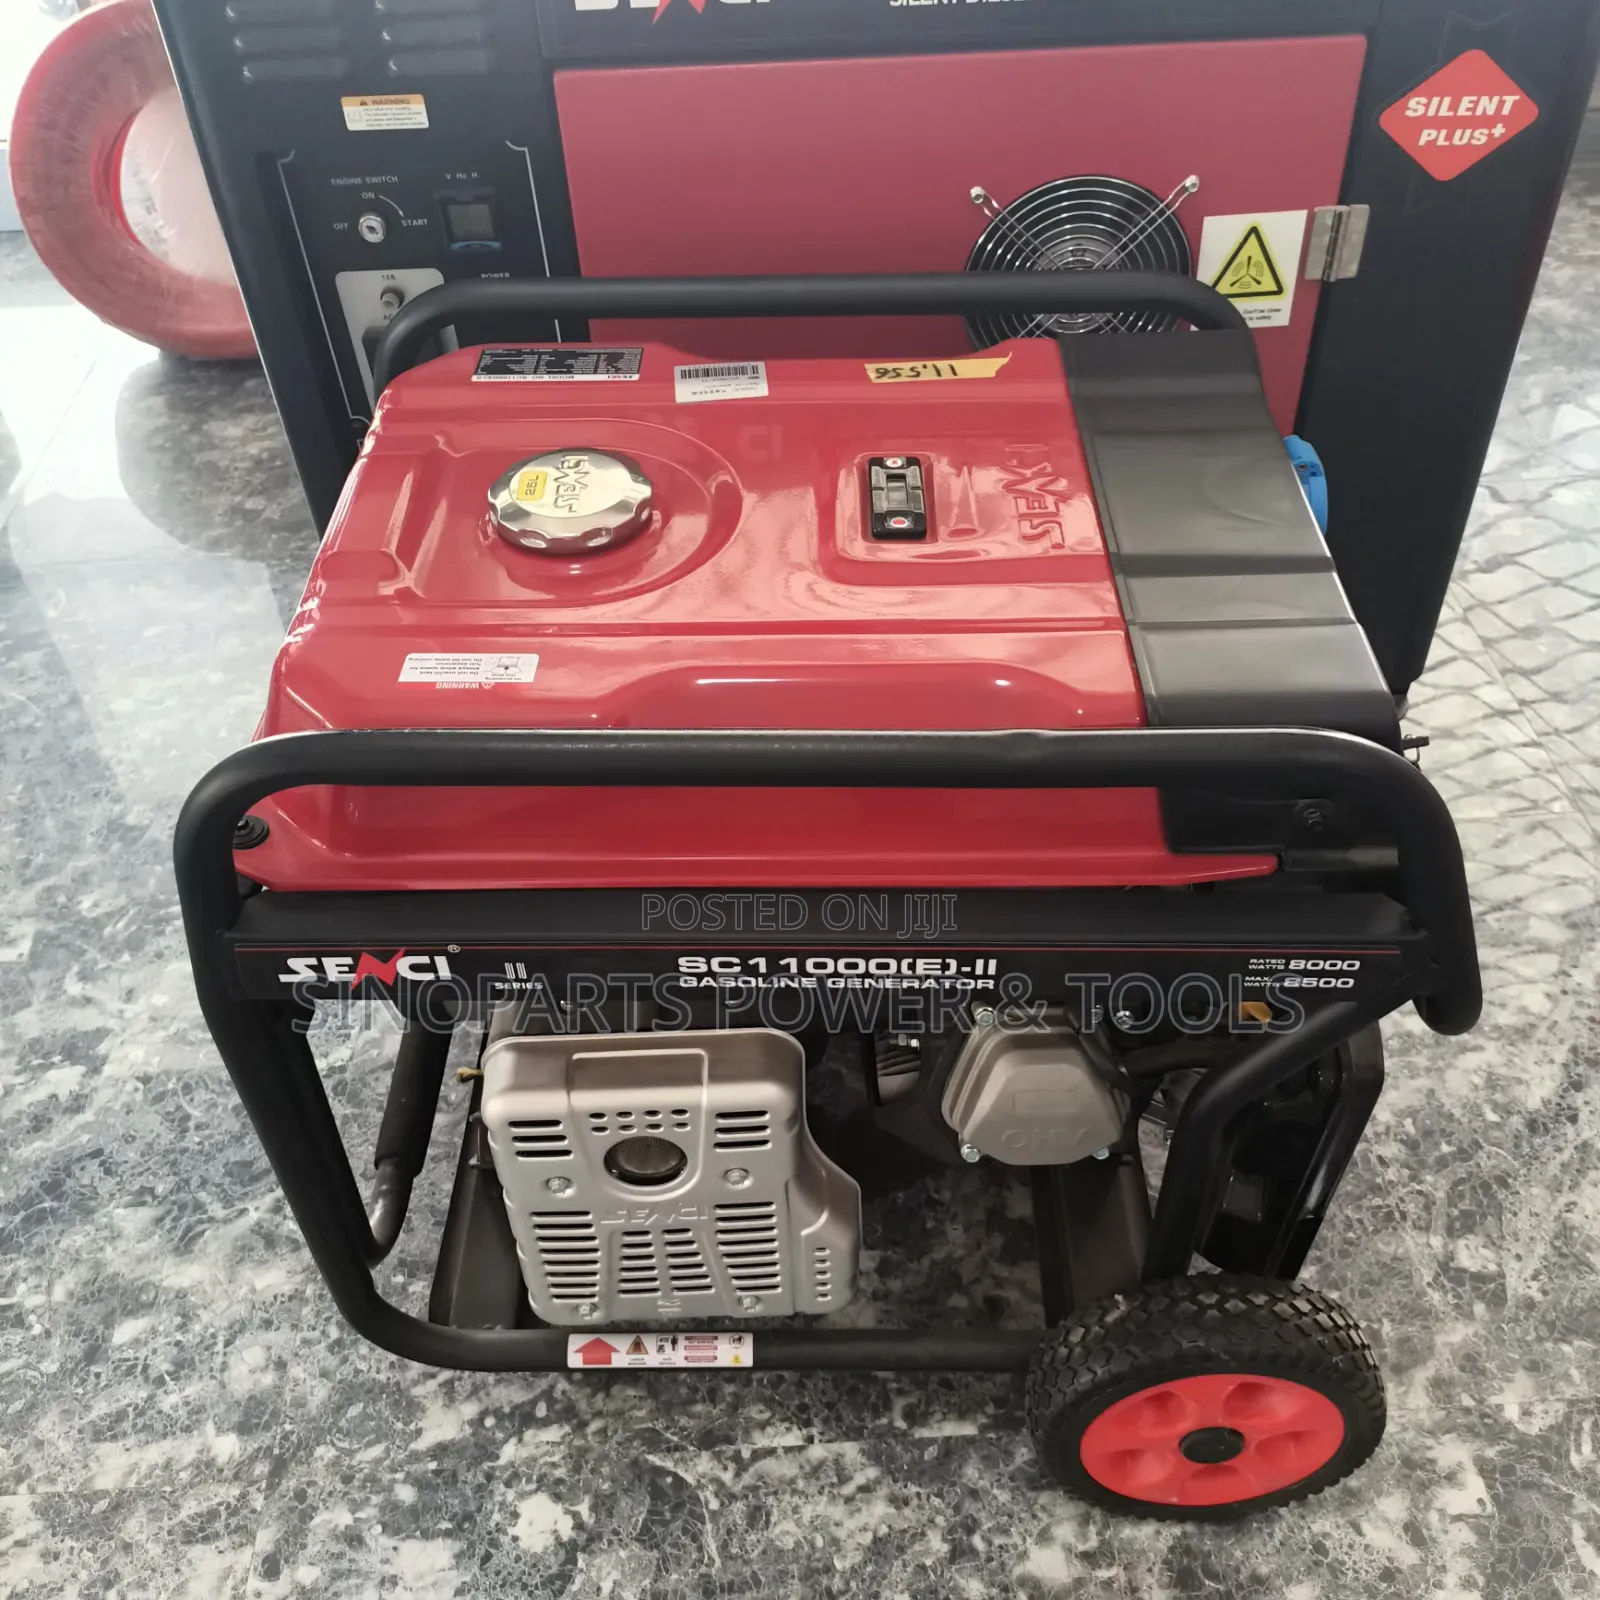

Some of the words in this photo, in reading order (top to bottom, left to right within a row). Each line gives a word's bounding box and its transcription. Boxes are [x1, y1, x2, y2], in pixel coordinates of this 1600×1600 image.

[1405, 96, 1520, 117] SILENT
[1418, 123, 1506, 146] PLUS+
[365, 175, 398, 184] SWITCH
[402, 219, 428, 227] START
[525, 475, 539, 495] 25L
[436, 681, 479, 689] WARNING
[1288, 959, 1361, 971] 8000
[494, 982, 544, 990] SERIES
[679, 977, 818, 988] GASOLINE
[826, 978, 996, 990] GENERATOR
[1283, 977, 1355, 988] 8500
